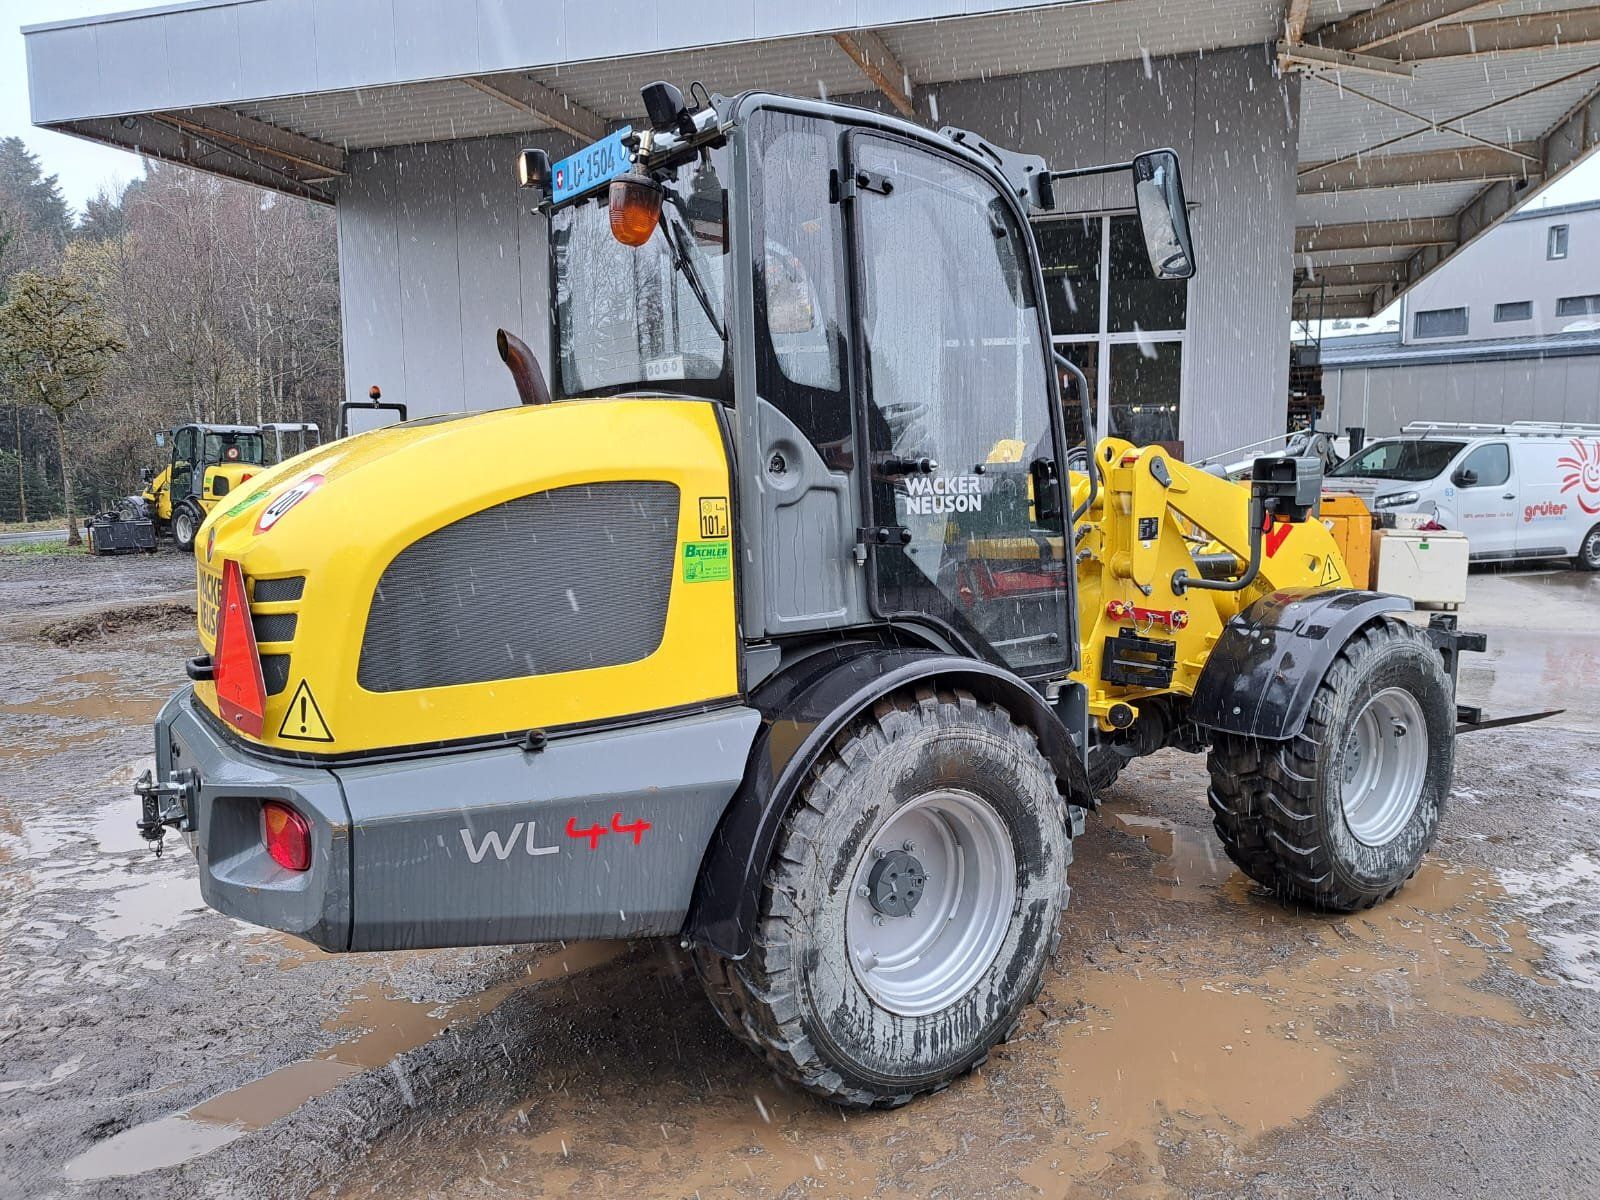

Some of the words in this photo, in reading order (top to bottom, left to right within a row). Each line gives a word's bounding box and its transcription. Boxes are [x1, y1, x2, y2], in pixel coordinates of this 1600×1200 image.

[904, 477, 981, 495] WACKER
[906, 494, 982, 515] NEUSON
[703, 515, 719, 535] 101
[459, 821, 560, 864] WL
[565, 812, 651, 850] 44
